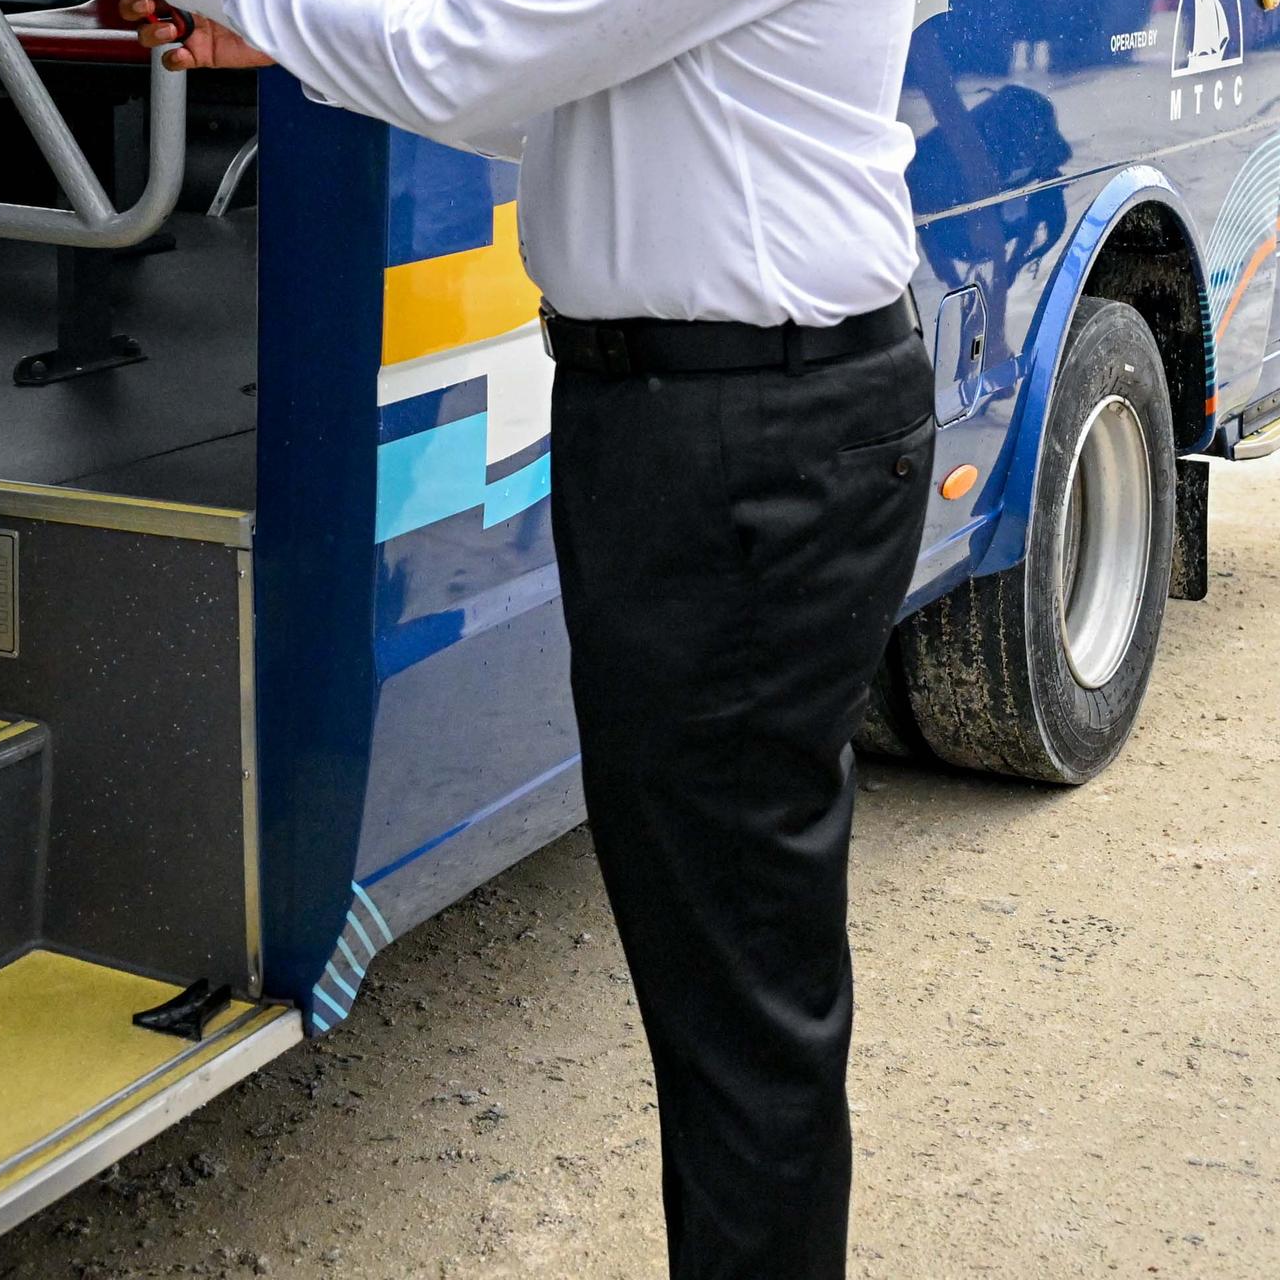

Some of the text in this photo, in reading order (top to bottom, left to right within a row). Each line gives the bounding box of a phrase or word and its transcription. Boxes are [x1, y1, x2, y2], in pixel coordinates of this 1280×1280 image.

[1110, 29, 1158, 52] OPERATED BY
[1170, 75, 1244, 121] MTCC
